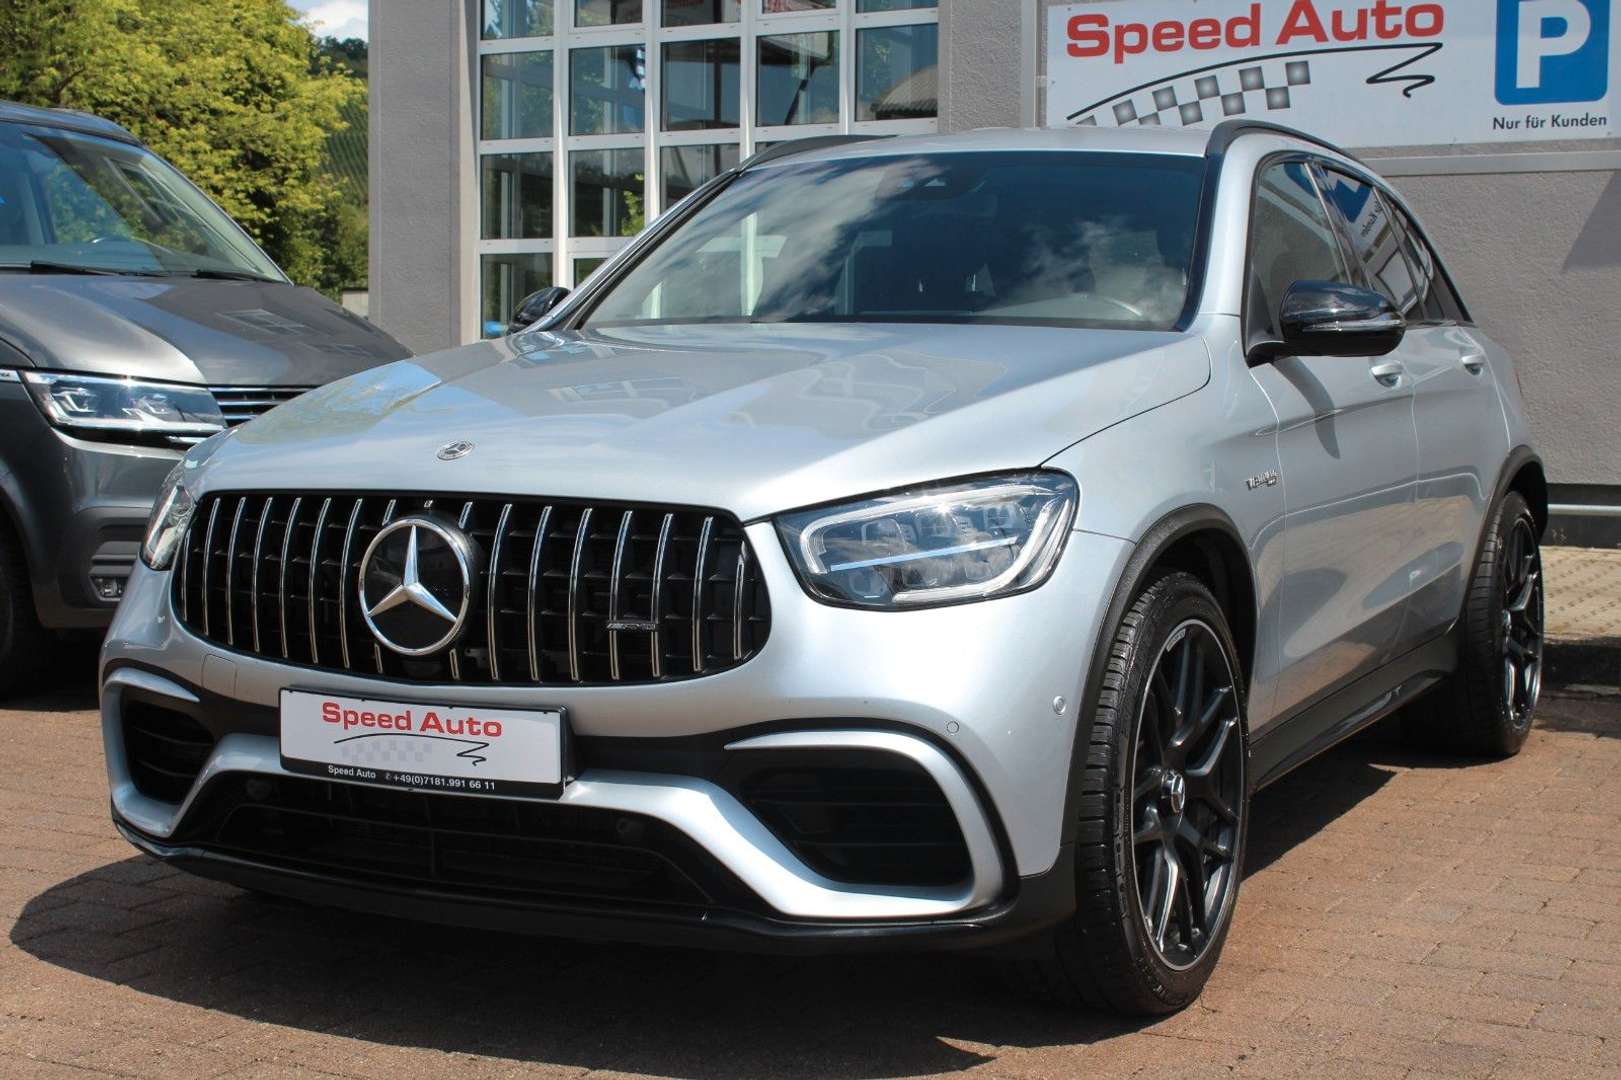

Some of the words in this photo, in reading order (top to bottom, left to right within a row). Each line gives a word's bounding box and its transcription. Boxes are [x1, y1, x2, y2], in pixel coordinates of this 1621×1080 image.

[1067, 3, 1261, 64] Speed
[1275, 0, 1444, 45] Auto
[1516, 0, 1591, 88] P
[1493, 116, 1521, 130] Nur
[1526, 114, 1546, 129] für
[1551, 112, 1607, 128] Kunden
[322, 701, 412, 730] Speed
[420, 712, 502, 737] Auto
[328, 765, 354, 776] Speed
[356, 768, 376, 779] Auto
[484, 781, 496, 790] 11
